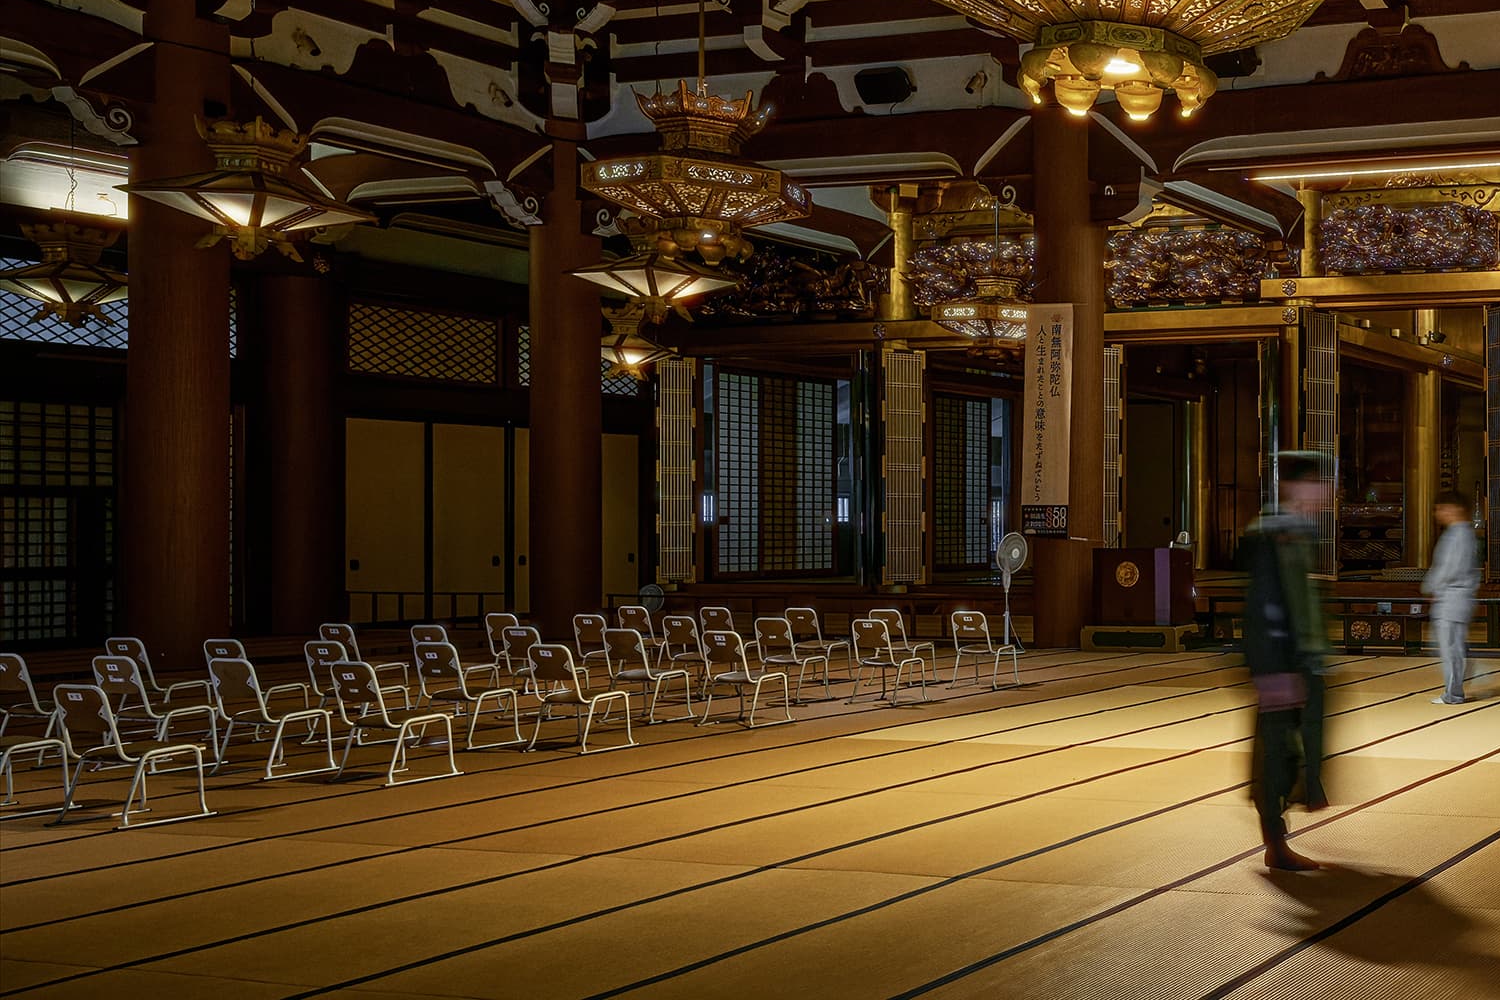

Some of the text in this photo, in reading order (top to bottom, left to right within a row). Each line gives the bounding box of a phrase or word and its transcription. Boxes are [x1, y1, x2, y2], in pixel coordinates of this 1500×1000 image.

[1050, 323, 1062, 398] 南無阿弥陀仏
